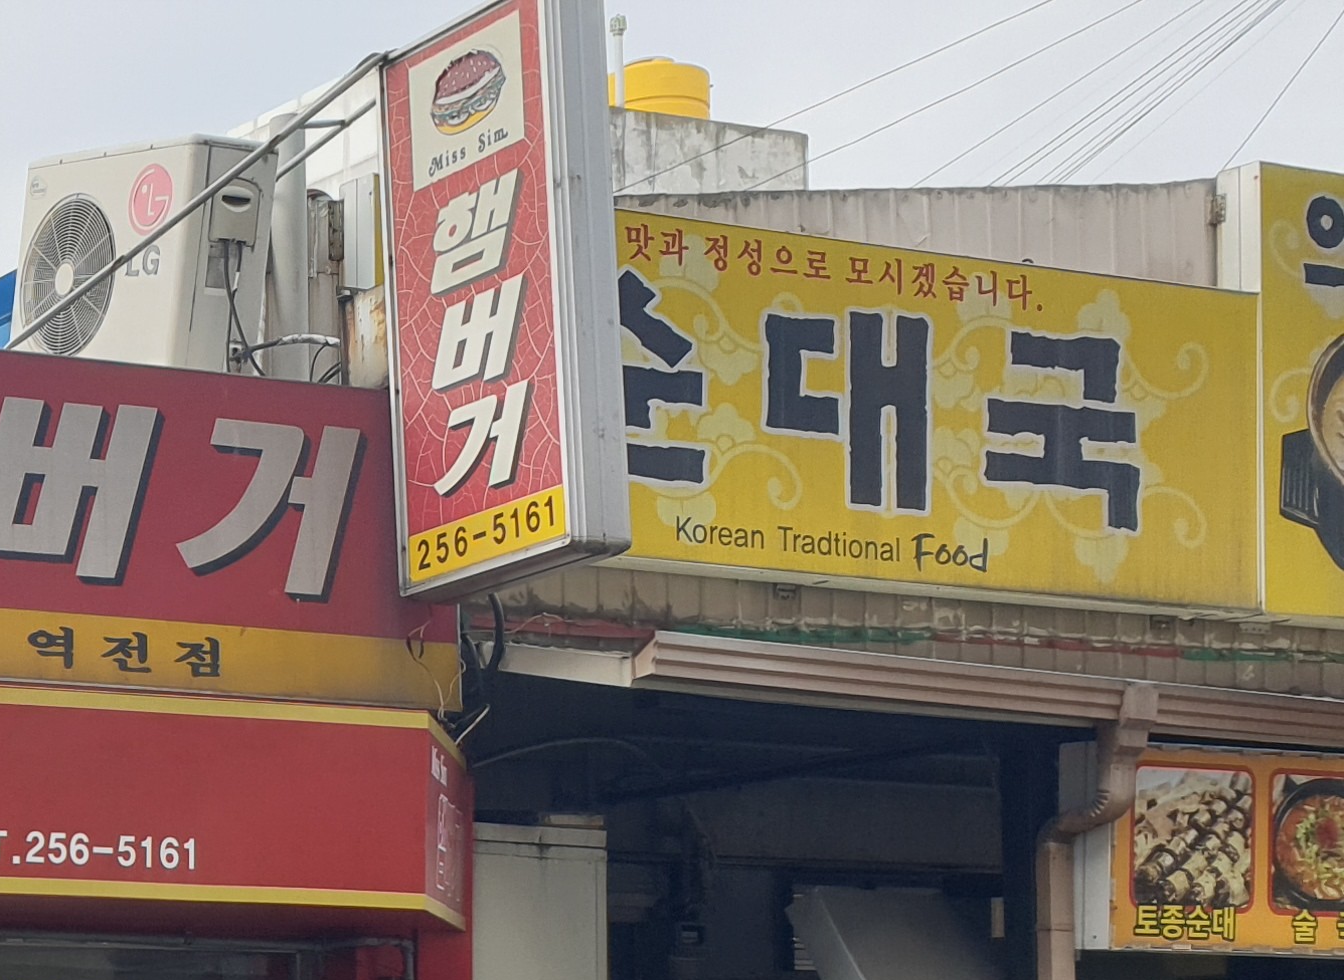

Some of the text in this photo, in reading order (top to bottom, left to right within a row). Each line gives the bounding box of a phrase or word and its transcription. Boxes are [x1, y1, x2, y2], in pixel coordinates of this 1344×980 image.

[429, 127, 509, 177] Miss Sim
[125, 244, 160, 277] LG
[624, 223, 1044, 312] 맛과 정성으로 모시겠습니다.
[431, 168, 530, 498] 햄버거
[417, 495, 555, 571] 256-5161
[675, 515, 989, 573] Korean Tradtional Food
[26, 625, 221, 678] 역전점
[1134, 904, 1236, 941] 토종순대
